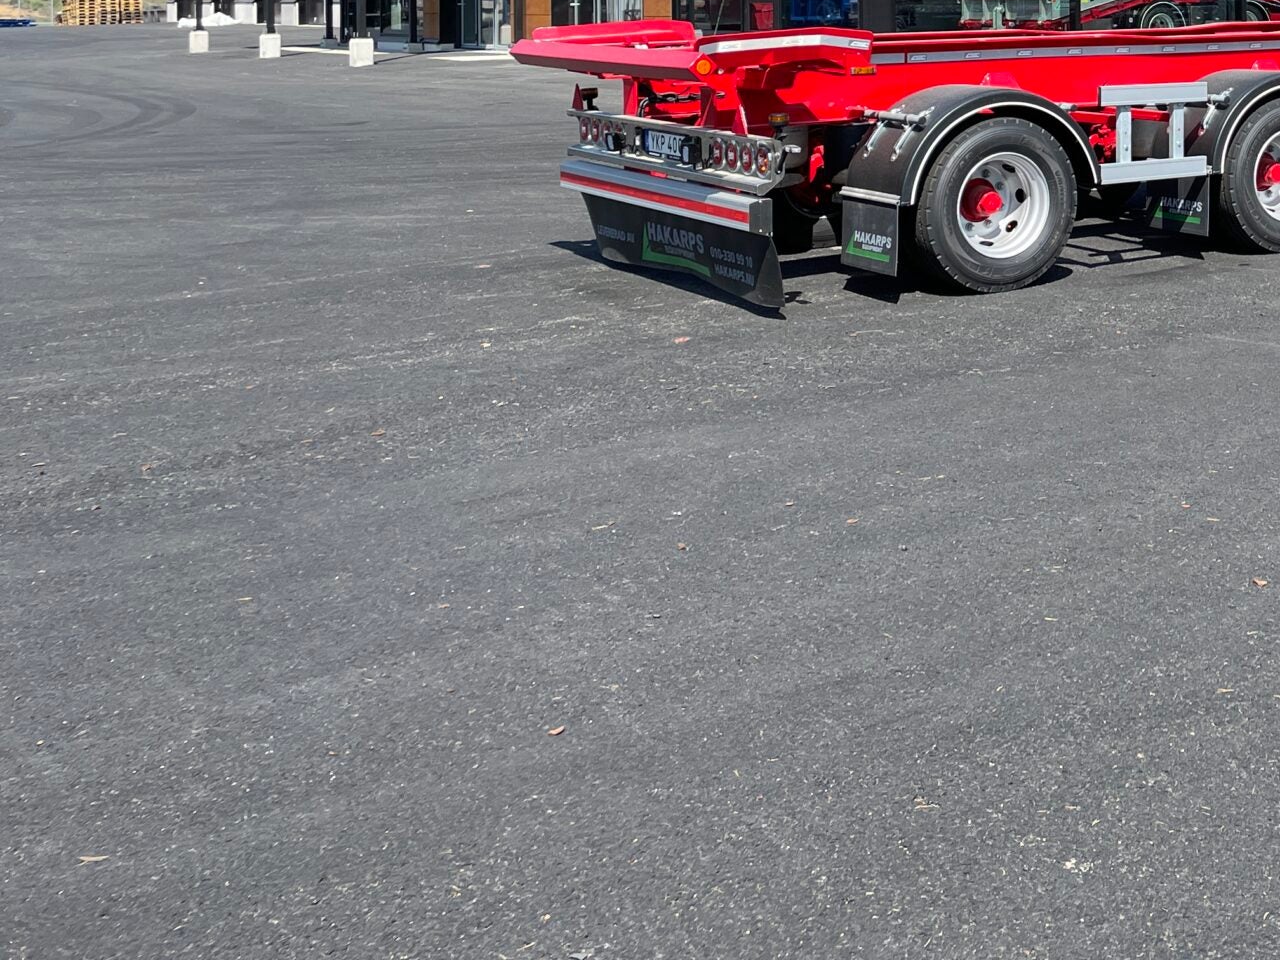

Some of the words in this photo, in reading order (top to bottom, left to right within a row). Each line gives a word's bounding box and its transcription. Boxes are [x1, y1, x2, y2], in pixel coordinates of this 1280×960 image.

[651, 133, 665, 150] YKP
[1160, 196, 1203, 212] HAKARPS
[647, 221, 704, 254] HAKARPS
[854, 230, 892, 249] HAKARPS
